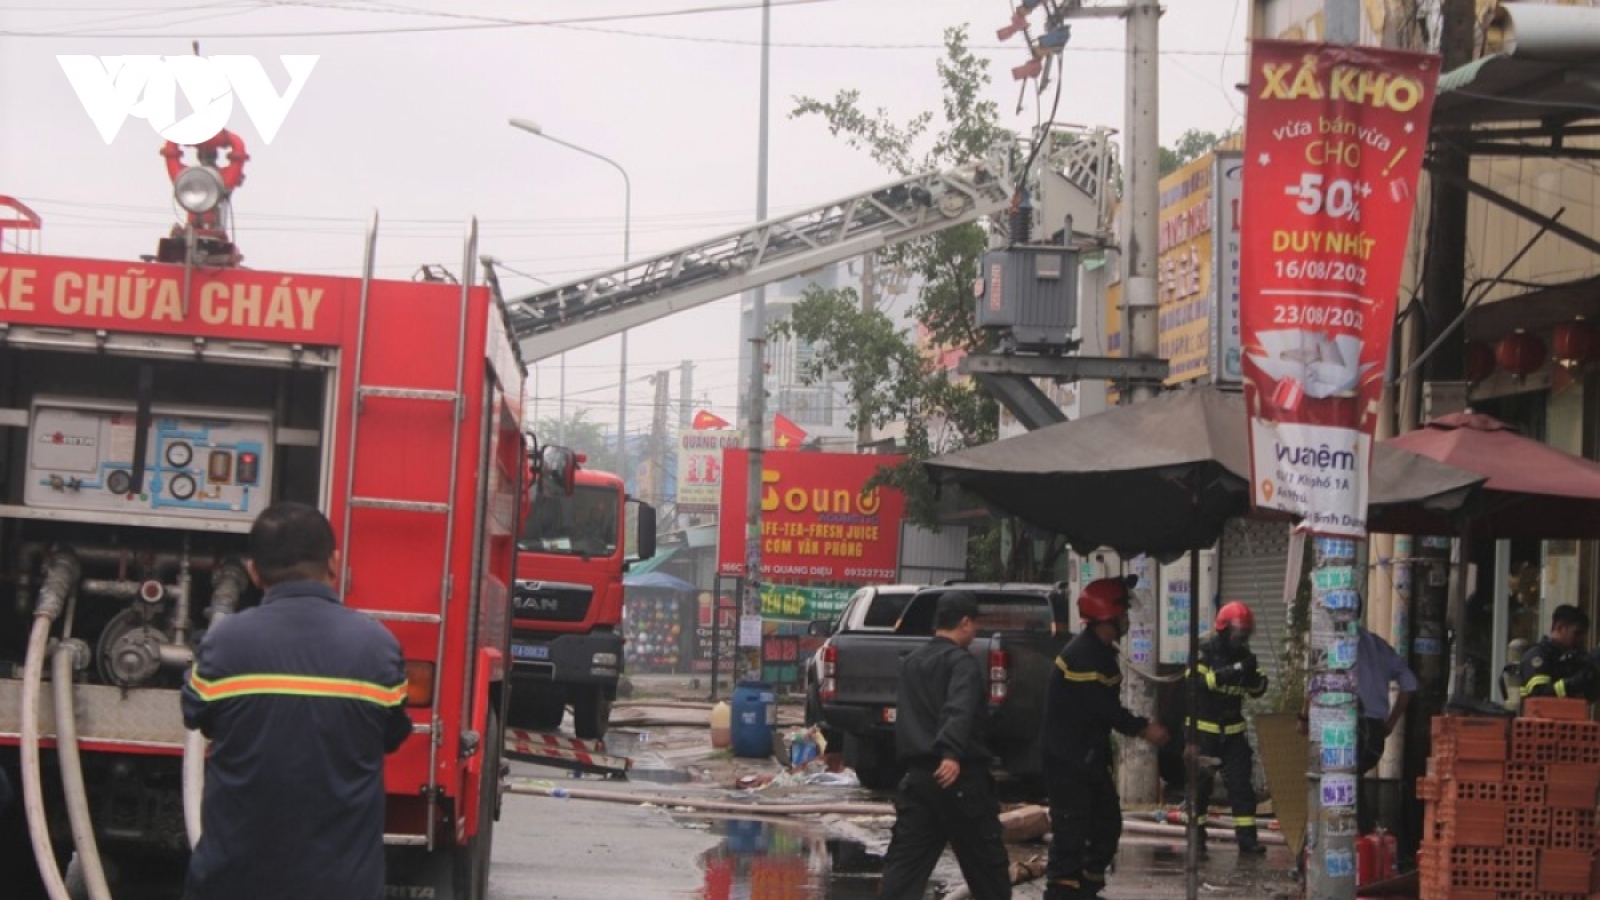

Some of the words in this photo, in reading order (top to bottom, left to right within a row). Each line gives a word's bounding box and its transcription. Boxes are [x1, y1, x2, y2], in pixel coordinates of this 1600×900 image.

[1330, 65, 1424, 112] KHO
[1318, 115, 1357, 135] bán
[1304, 140, 1361, 168] CHO
[1272, 229, 1322, 253] DUY
[53, 267, 184, 322] CHỮA
[200, 276, 324, 330] CHÁY
[846, 524, 879, 541] JUICE
